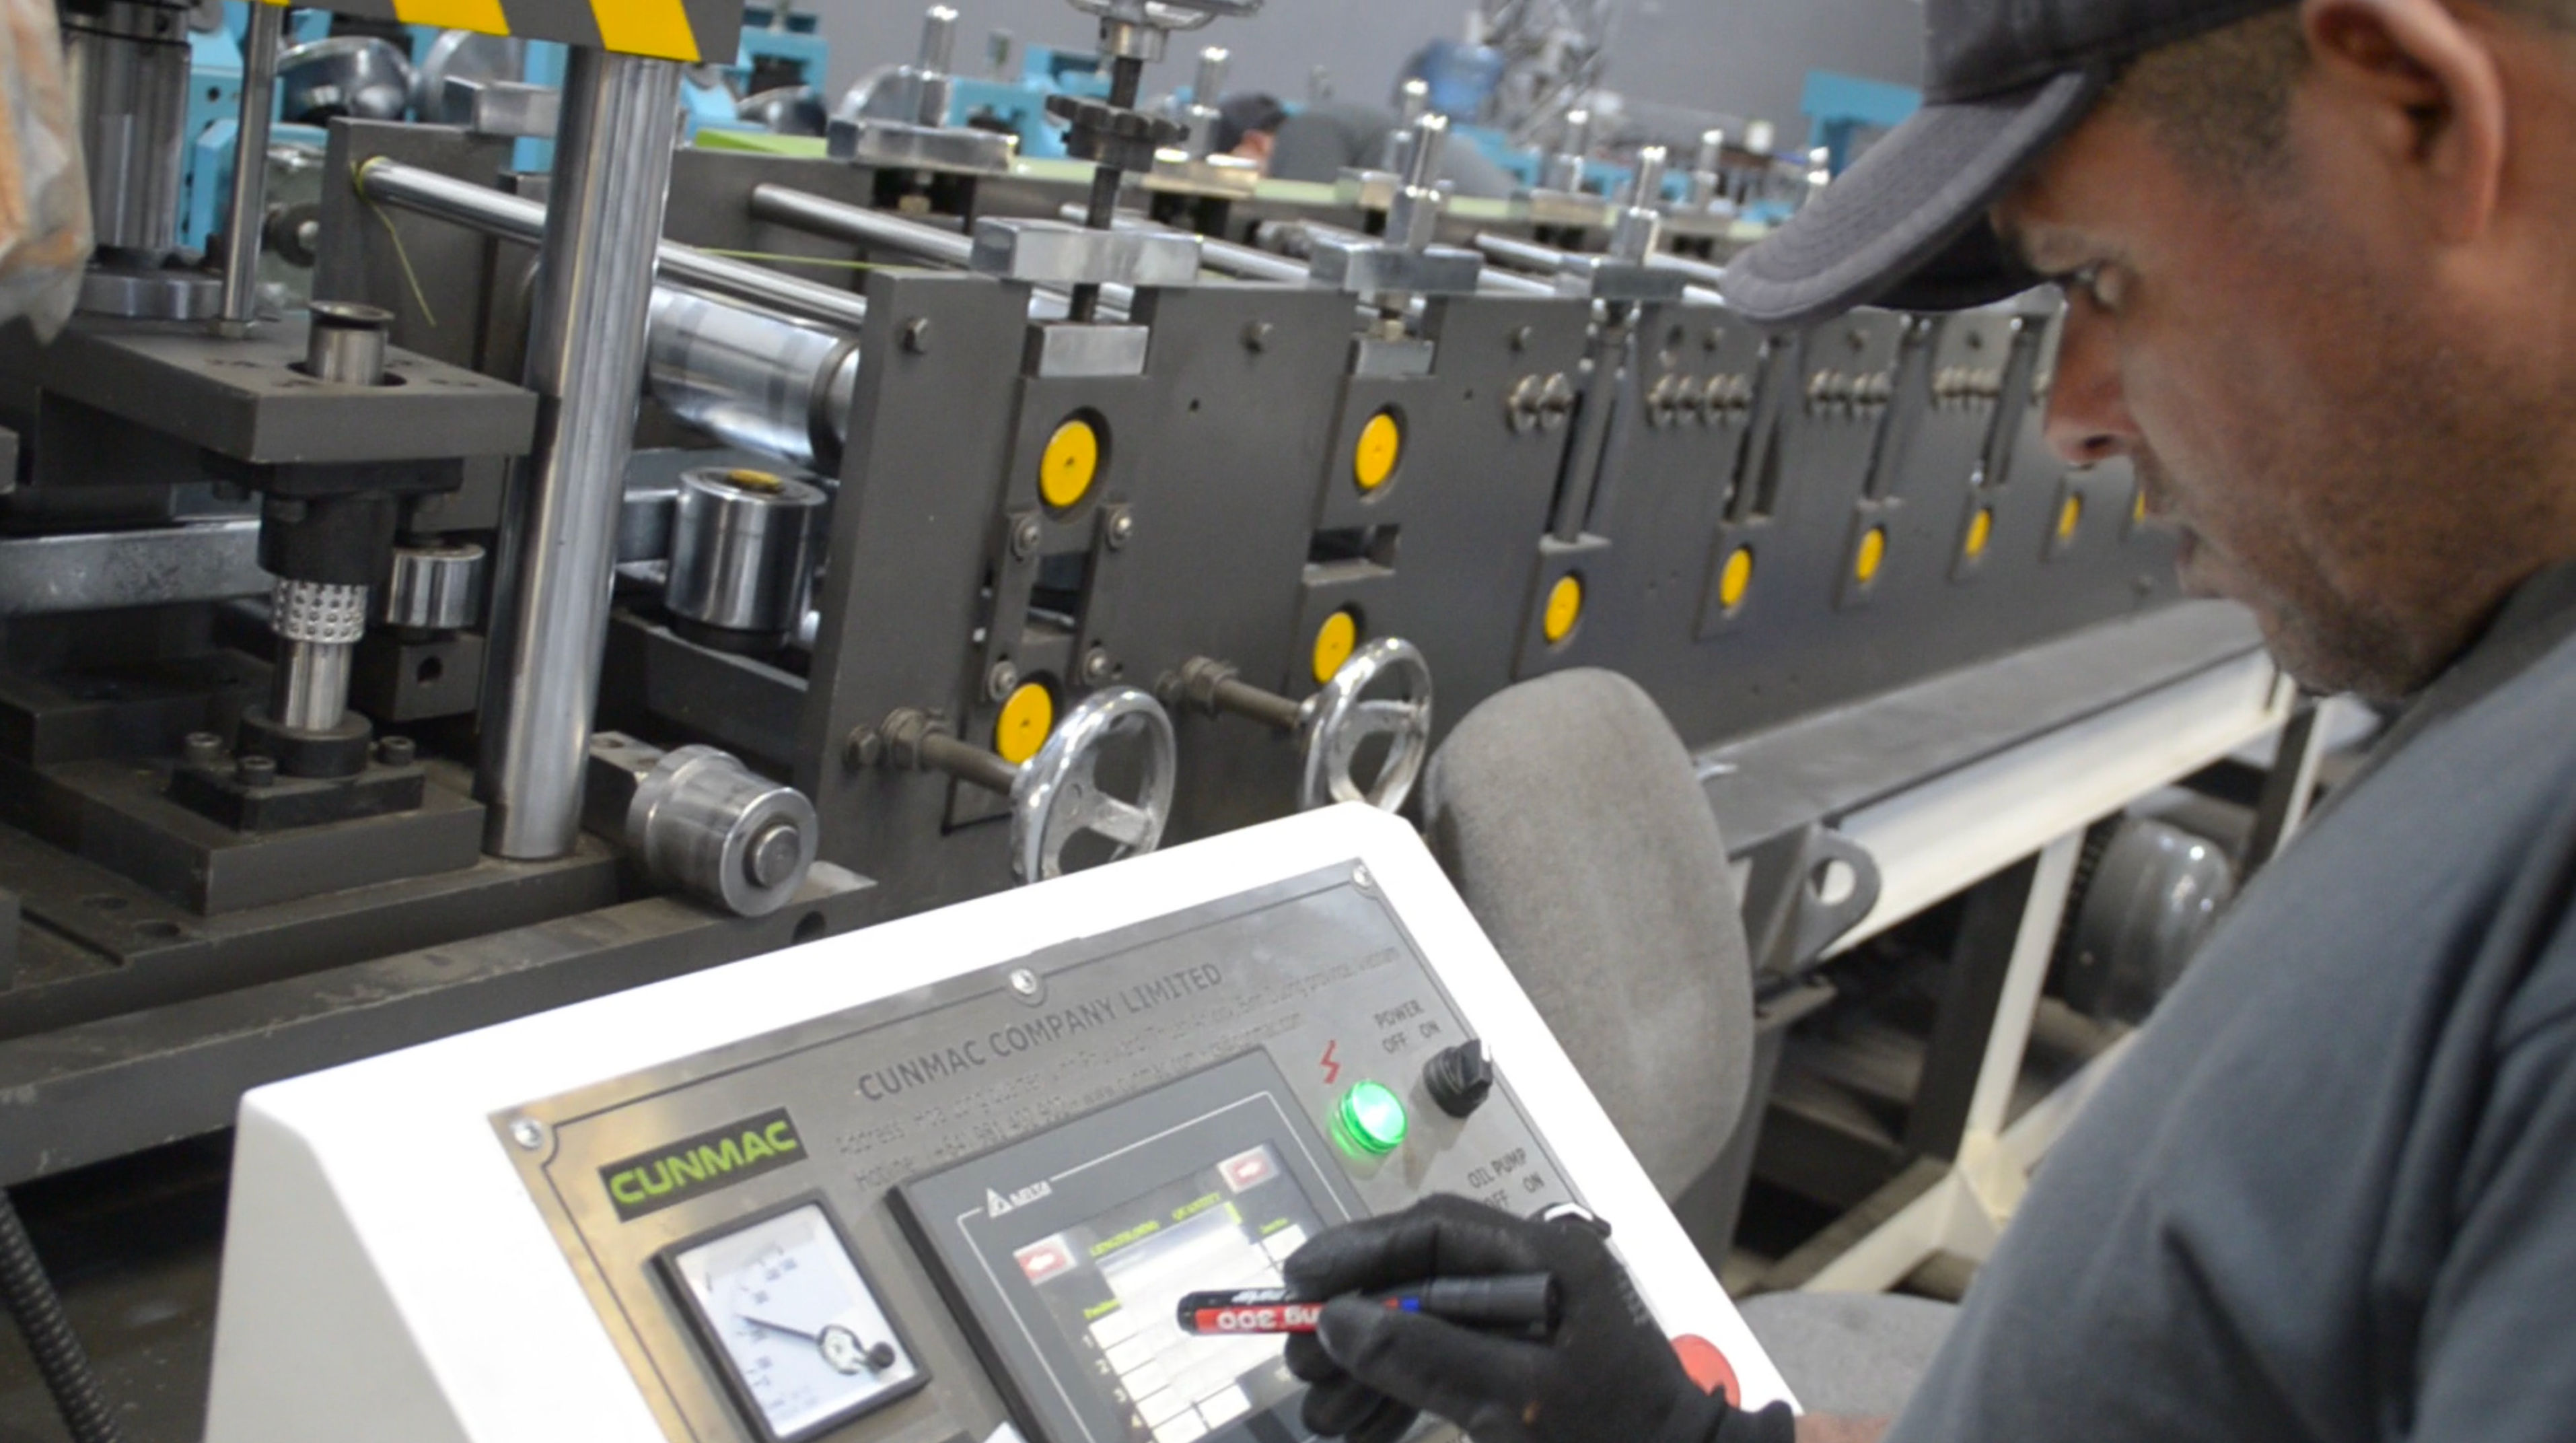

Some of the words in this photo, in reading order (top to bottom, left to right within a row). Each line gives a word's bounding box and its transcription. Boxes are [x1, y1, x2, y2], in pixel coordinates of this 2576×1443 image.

[1373, 999, 1425, 1030] POWER
[858, 1040, 987, 1101] CUNMAC
[989, 996, 1116, 1057] COMPANY
[1120, 963, 1223, 1012] LIMITED
[1382, 1032, 1406, 1054] OFF
[1419, 1020, 1441, 1038] ON
[610, 1120, 797, 1204] CUNMAC
[1467, 1166, 1495, 1189] OIL
[1491, 1147, 1526, 1175] PUMP
[1523, 1172, 1545, 1193] ON
[1217, 1309, 1277, 1330] 300
